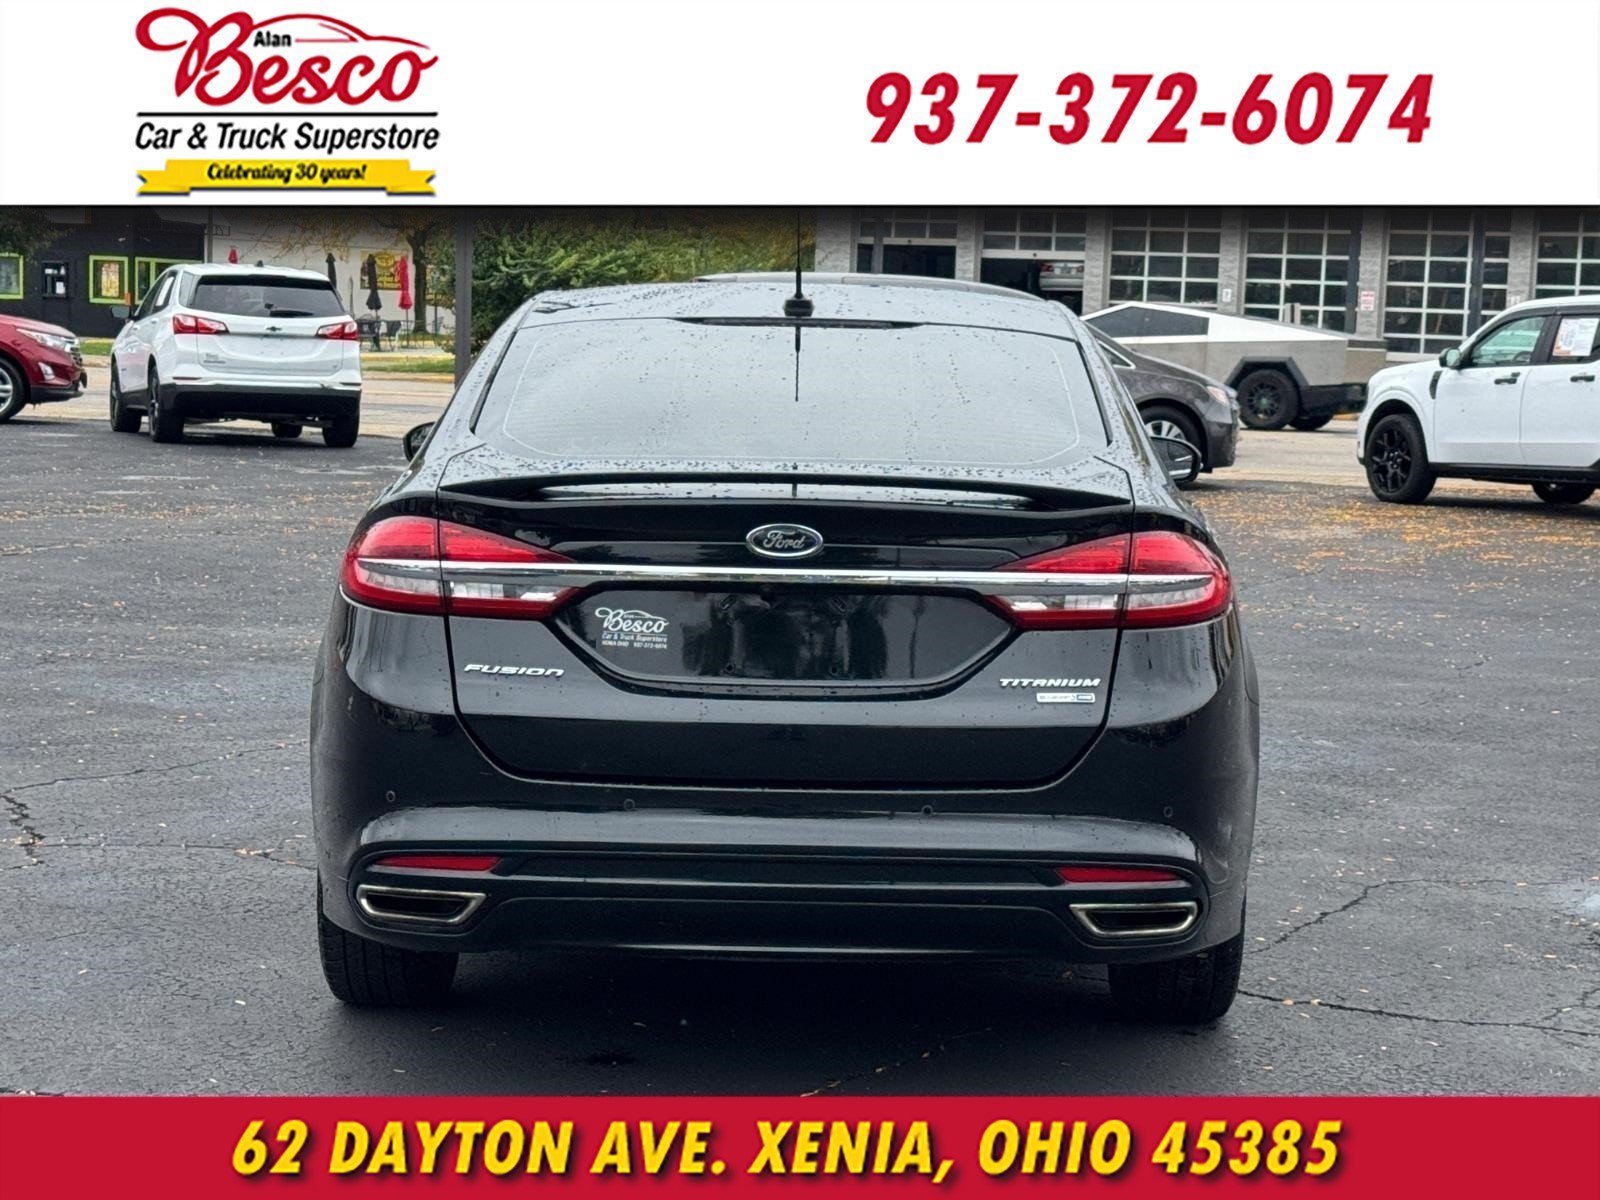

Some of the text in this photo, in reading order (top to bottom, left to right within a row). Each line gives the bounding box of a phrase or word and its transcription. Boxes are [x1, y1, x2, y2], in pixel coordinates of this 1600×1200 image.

[763, 530, 806, 549] Ford
[595, 607, 669, 633] Besco
[464, 664, 565, 677] FUSION
[1000, 678, 1101, 688] TITANIUM
